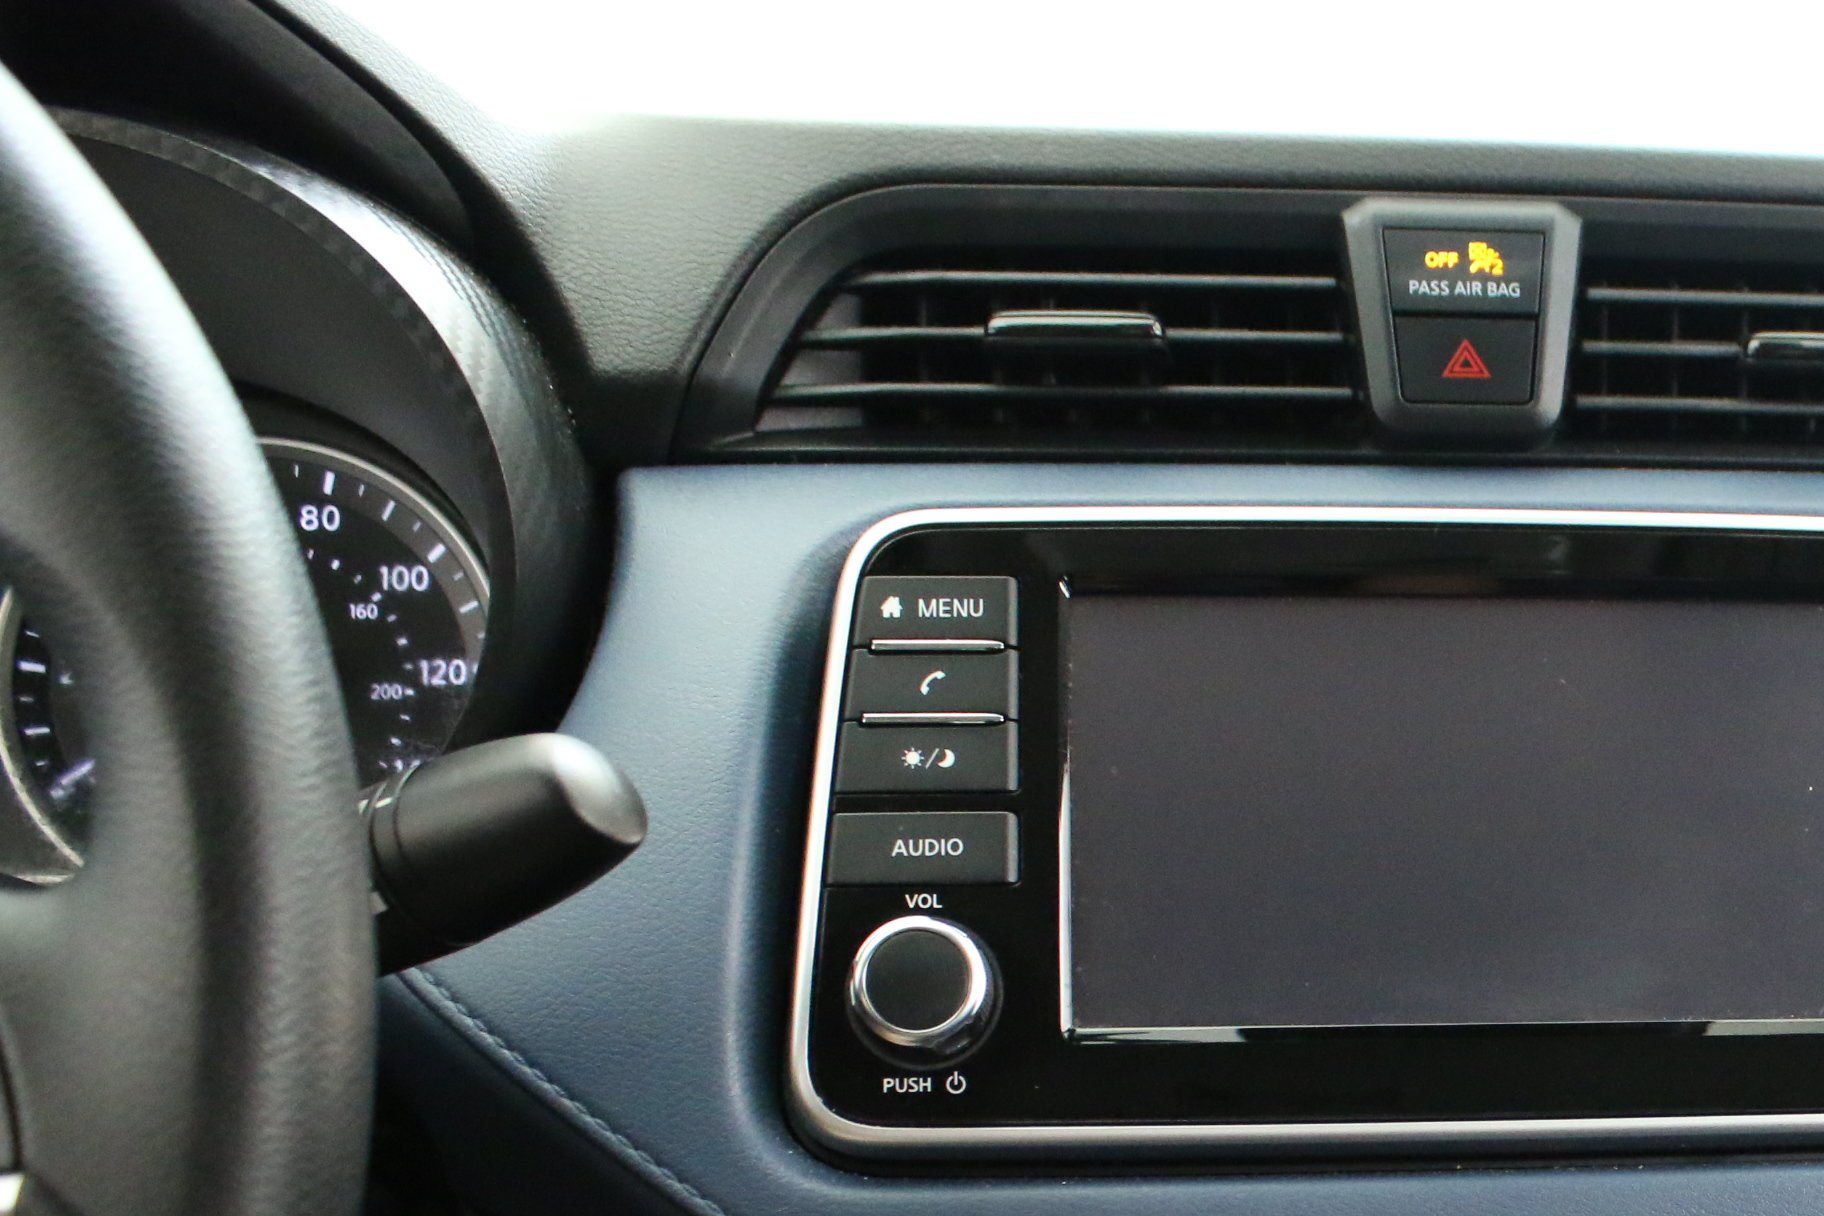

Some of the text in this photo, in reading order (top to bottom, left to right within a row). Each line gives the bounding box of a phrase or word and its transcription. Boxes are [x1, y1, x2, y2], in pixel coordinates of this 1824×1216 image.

[1424, 251, 1459, 269] OFF
[1408, 279, 1521, 298] PASS AIR BAG
[300, 504, 341, 532] 80
[379, 565, 430, 592] 100
[349, 602, 379, 620] 160
[917, 598, 985, 619] MENU
[419, 659, 468, 687] 120
[370, 683, 402, 700] 200
[891, 837, 964, 858] AUDIO
[904, 893, 943, 910] VOL
[882, 1076, 932, 1094] PUSH
